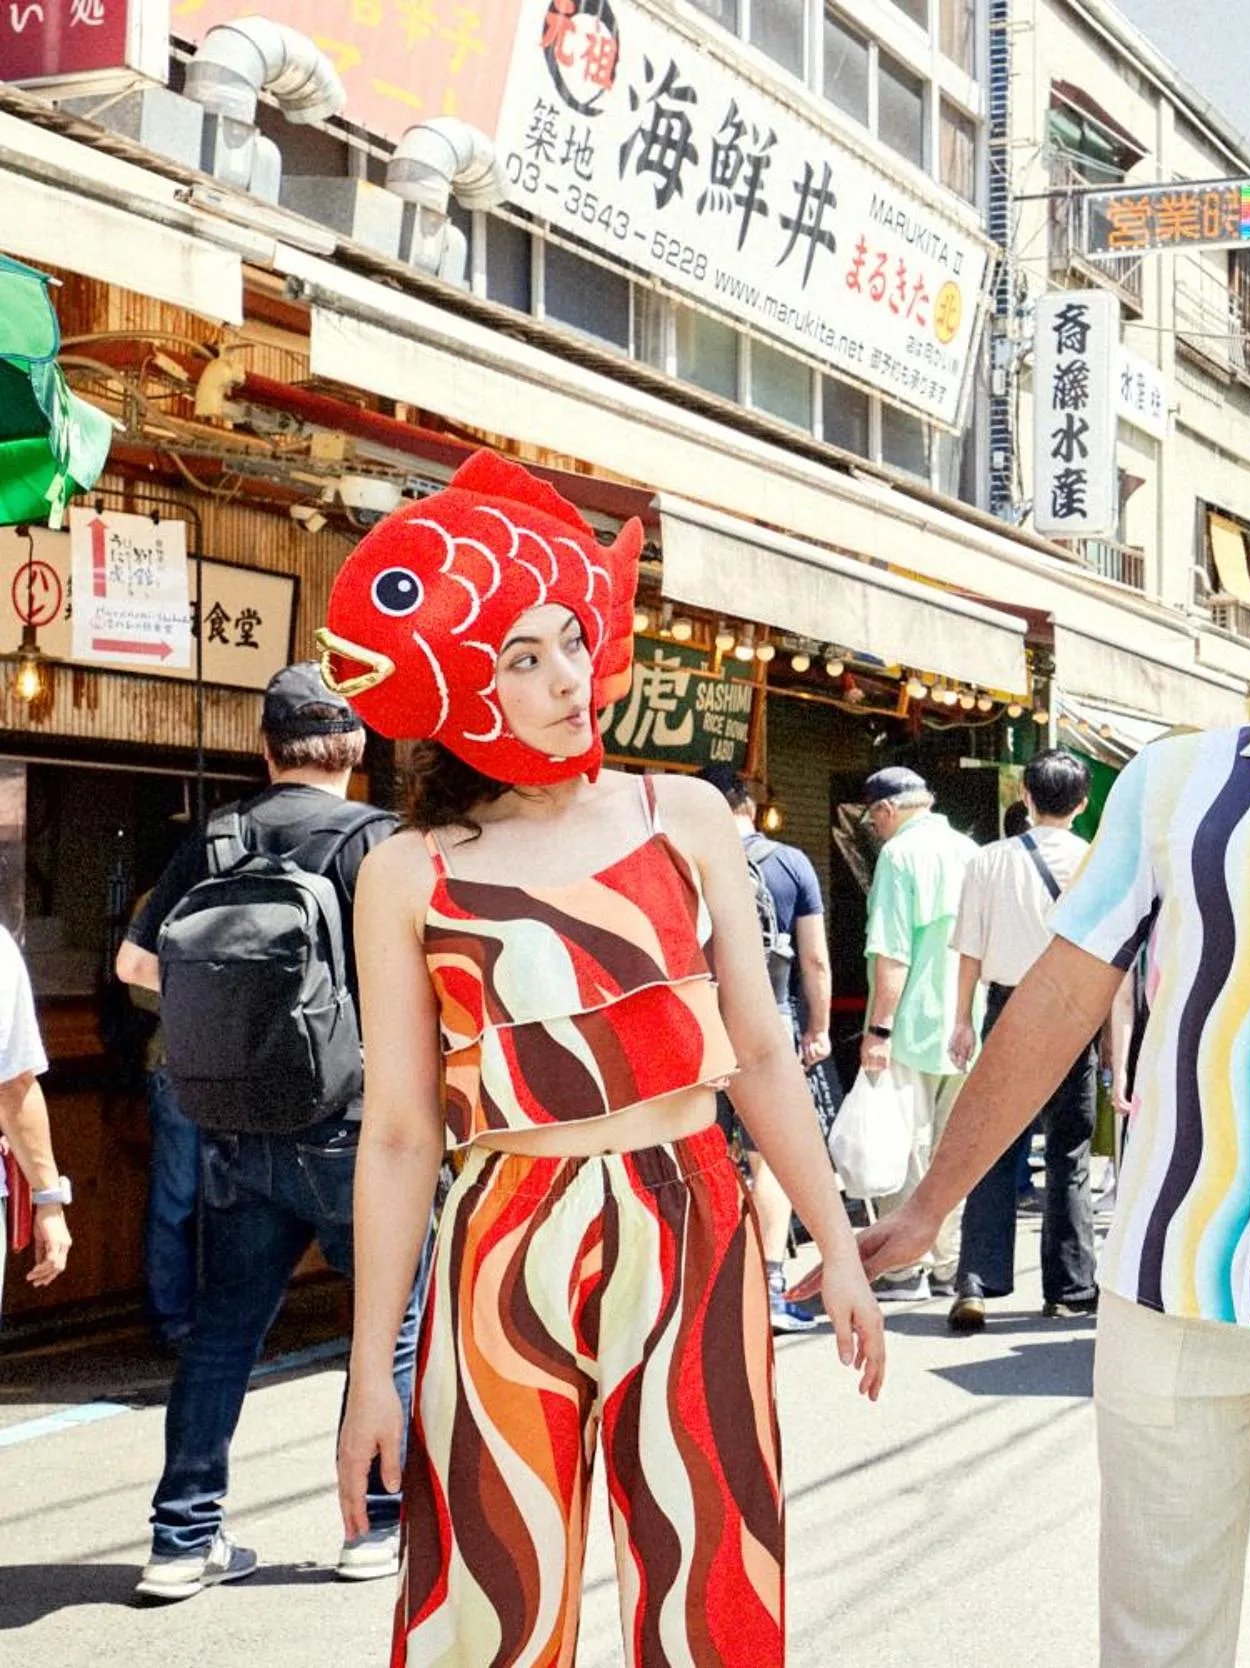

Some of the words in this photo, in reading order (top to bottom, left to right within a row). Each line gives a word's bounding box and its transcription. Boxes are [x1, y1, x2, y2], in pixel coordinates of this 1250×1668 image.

[524, 97, 596, 182] 築地
[619, 54, 838, 291] 海鮮丼
[505, 152, 709, 282] 03-3543-5228
[714, 268, 866, 363] www.marukita.net
[869, 193, 949, 268] MARUKITA
[845, 233, 929, 327] まるきた
[597, 648, 694, 749] 虎
[696, 681, 753, 713] SASHIMI
[703, 711, 725, 735] RICE
